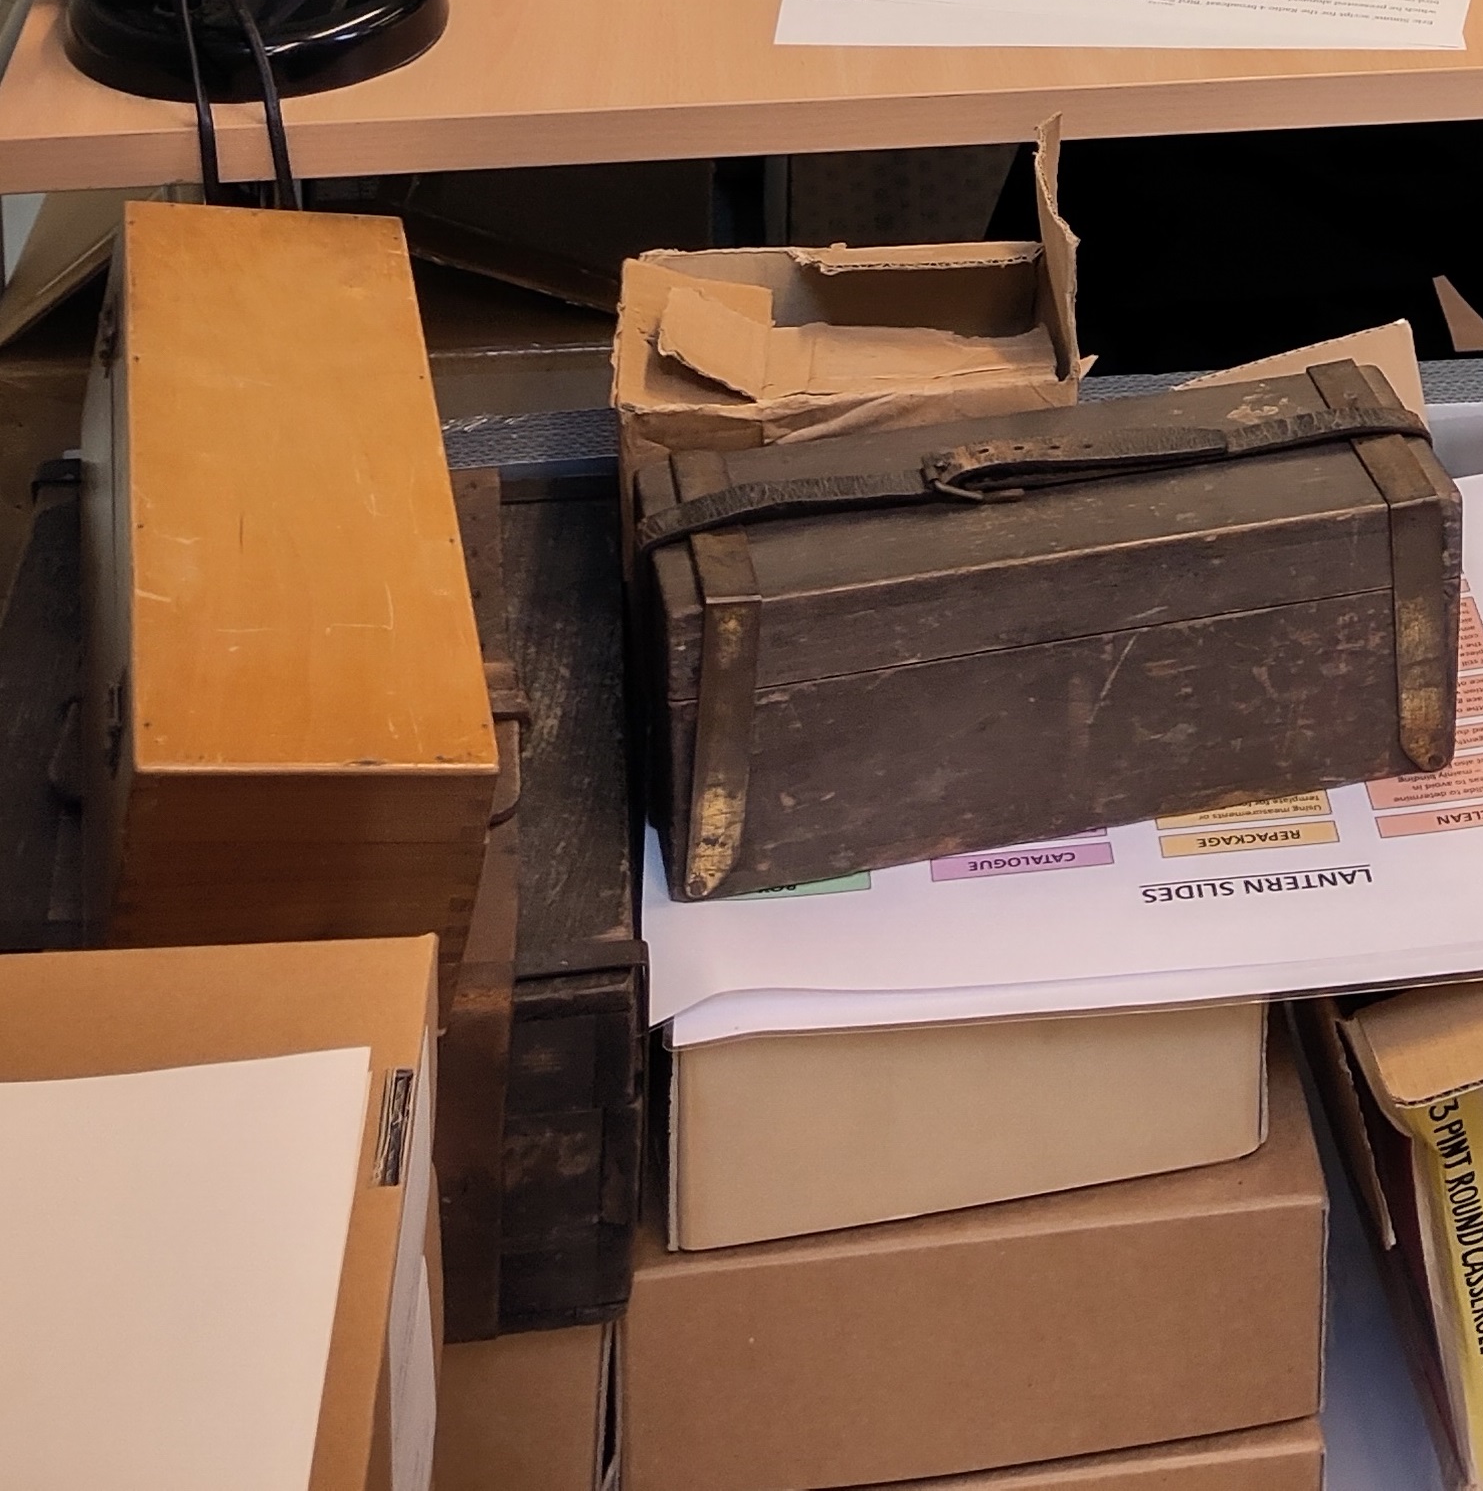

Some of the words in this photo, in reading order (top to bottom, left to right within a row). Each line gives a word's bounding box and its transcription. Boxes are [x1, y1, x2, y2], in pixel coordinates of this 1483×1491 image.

[1453, 759, 1474, 767] also
[1438, 768, 1473, 780] mainly
[1424, 780, 1453, 790] avoid
[1393, 791, 1448, 803] determine
[1212, 806, 1291, 822] measurements
[1292, 802, 1323, 815] Using
[1195, 829, 1302, 849] REPACKAGE
[967, 851, 1077, 873] CATALOGUE
[1242, 867, 1373, 894] LANTERN
[1140, 881, 1235, 904] SLIDES
[1429, 1097, 1460, 1122] 3
[1434, 1116, 1473, 1171] PINT
